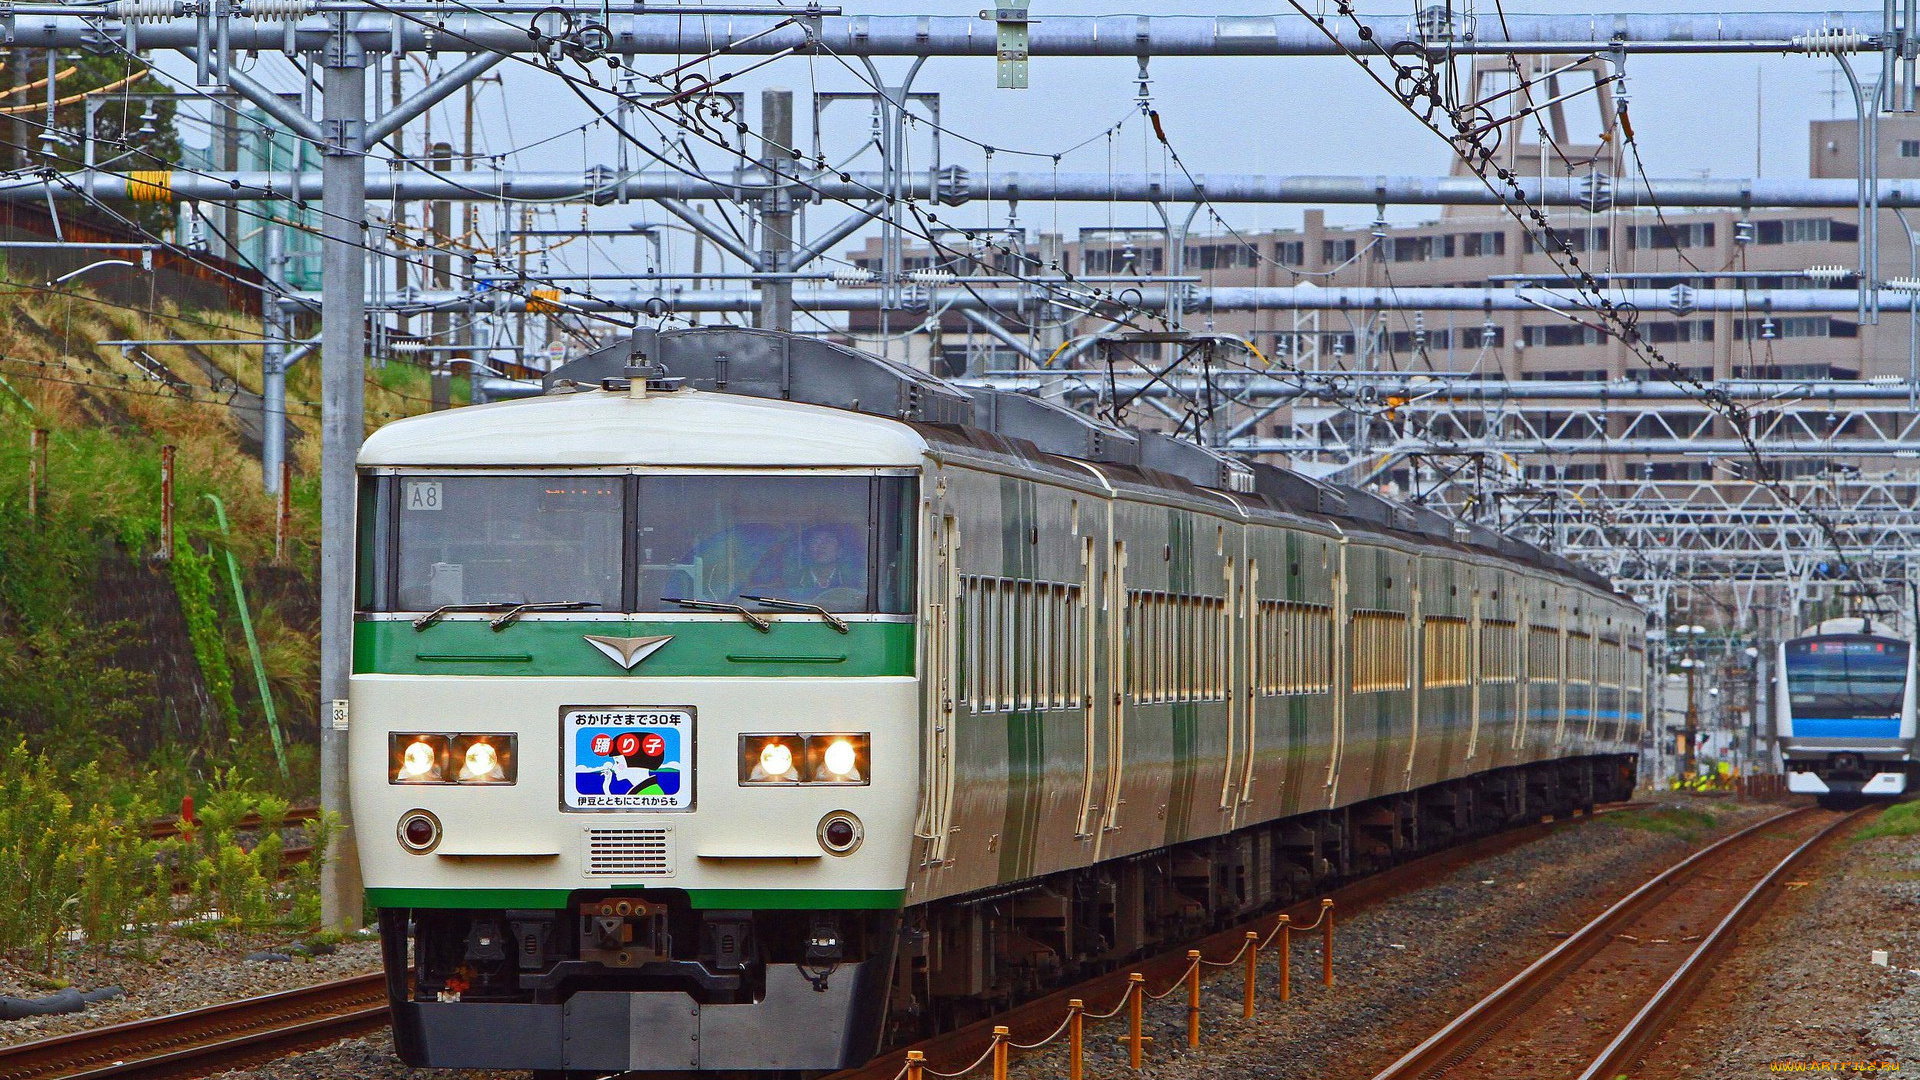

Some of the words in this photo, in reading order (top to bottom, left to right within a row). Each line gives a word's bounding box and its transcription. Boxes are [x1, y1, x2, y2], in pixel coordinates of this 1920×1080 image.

[413, 487, 437, 507] A8
[575, 714, 681, 726] おかげさまで30年
[593, 738, 662, 753] 踊り子
[577, 797, 678, 806] 伊豆とともにこれからも
